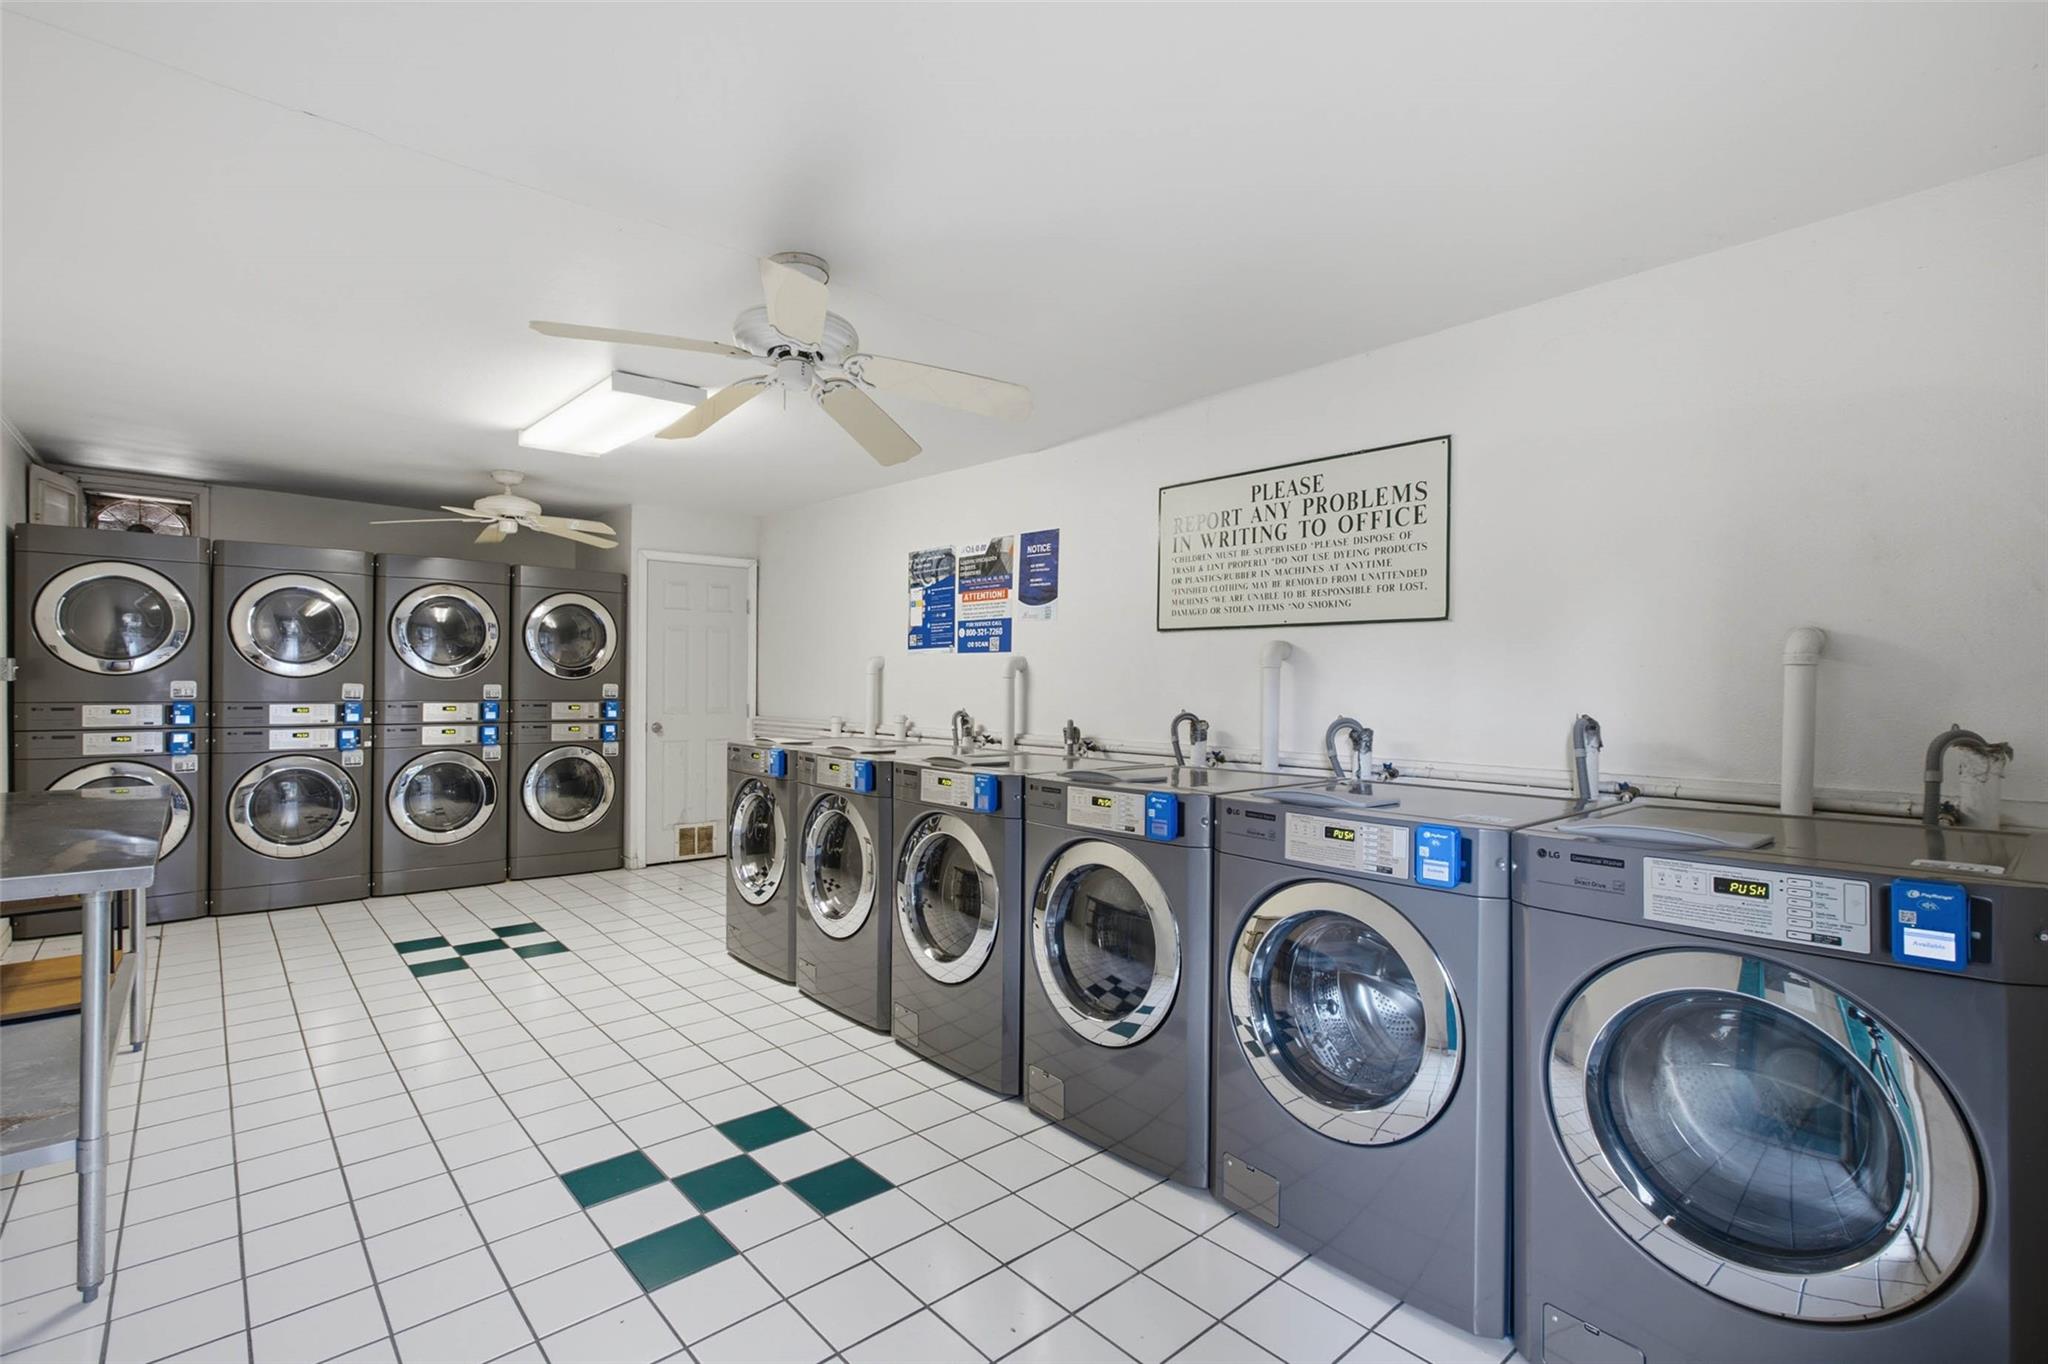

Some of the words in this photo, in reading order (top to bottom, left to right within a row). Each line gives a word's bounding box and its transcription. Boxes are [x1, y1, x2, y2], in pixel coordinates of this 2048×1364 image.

[1251, 473, 1325, 503] PLEASE
[1173, 508, 1243, 535] REPORT
[1250, 500, 1292, 524] ANY
[1302, 480, 1428, 517] PROBLEMS
[1171, 534, 1192, 554] IN
[1200, 523, 1288, 550] WRITING
[1298, 518, 1327, 539] TO
[1338, 503, 1428, 534] OFFICE
[1026, 543, 1052, 554] NOTICE
[1216, 550, 1237, 559] MUST
[1254, 542, 1307, 555] SUPERVISED
[1353, 532, 1395, 545] DISPOSE
[1399, 530, 1413, 540] OF
[1172, 565, 1196, 574] TRASH
[1207, 562, 1224, 571] LINT
[1227, 557, 1267, 569] PROPERLY
[1291, 554, 1308, 562] NOT
[1312, 552, 1330, 561] USE
[1333, 548, 1370, 559] DYEING
[1374, 542, 1428, 556] PRODUCTS
[1260, 569, 1271, 578] IN
[1274, 564, 1325, 576] MACHINES
[1329, 563, 1339, 572] AT
[1345, 558, 1393, 570] ANYTIME
[1210, 583, 1249, 593] CLOTHING
[1252, 580, 1268, 590] MAY
[1272, 580, 1280, 588] BE
[1285, 576, 1328, 588] REMOVED
[1331, 573, 1357, 584] FROM
[1361, 568, 1428, 581] UNATTENDED
[963, 590, 1006, 601] ATTENTION!
[1171, 597, 1209, 606] MACHINES
[1230, 594, 1243, 602] ARE
[1247, 591, 1279, 601] UNABLE
[1283, 591, 1294, 599] TO
[1297, 589, 1306, 598] BE
[1311, 585, 1372, 597] RESPONSIBLE
[1376, 583, 1395, 593] FOR
[1171, 608, 1208, 617] DAMAGED
[1224, 604, 1254, 614] STOLEN
[1258, 603, 1285, 612] ITEMS
[1307, 599, 1352, 609] SMOKING
[1548, 851, 1560, 860] LG
[1729, 881, 1767, 897] PUSH
